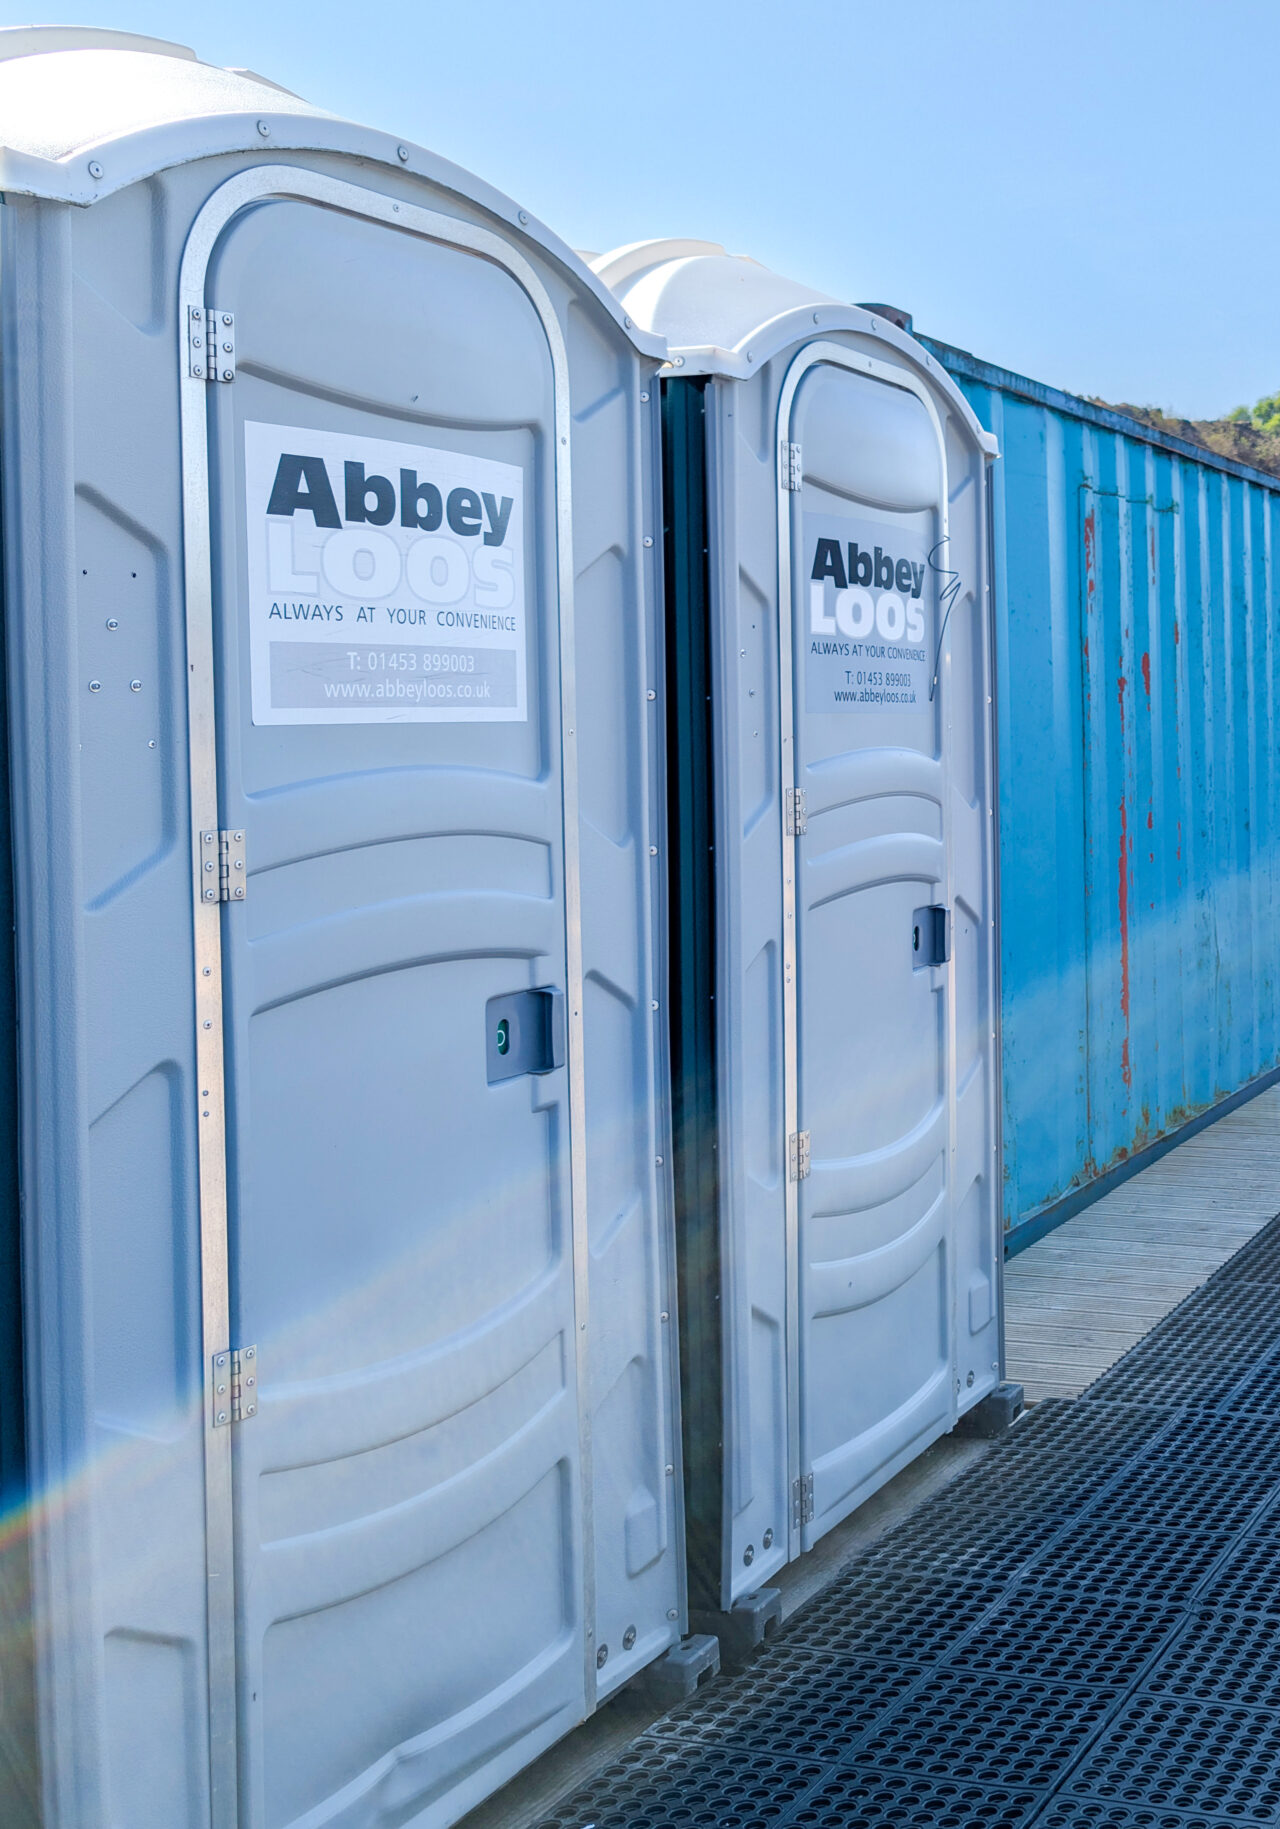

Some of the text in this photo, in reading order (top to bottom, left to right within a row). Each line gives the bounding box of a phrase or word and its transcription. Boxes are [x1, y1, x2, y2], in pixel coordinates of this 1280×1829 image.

[265, 452, 514, 547] Abbey
[265, 518, 516, 610] LOOS
[810, 537, 926, 599] Abbey
[268, 602, 516, 632] ALWAYS AT YOUR CONVENIENCE
[809, 581, 925, 643] LOOS
[346, 652, 475, 672] T: 01453 899003
[811, 641, 926, 662] ALWAYS AT YOUR CONVENIENCE
[845, 670, 911, 687] T: 01453 899003
[324, 681, 491, 703] www.abbeyloos.co.uk
[834, 688, 917, 705] www.abbeyloos.co.uk
